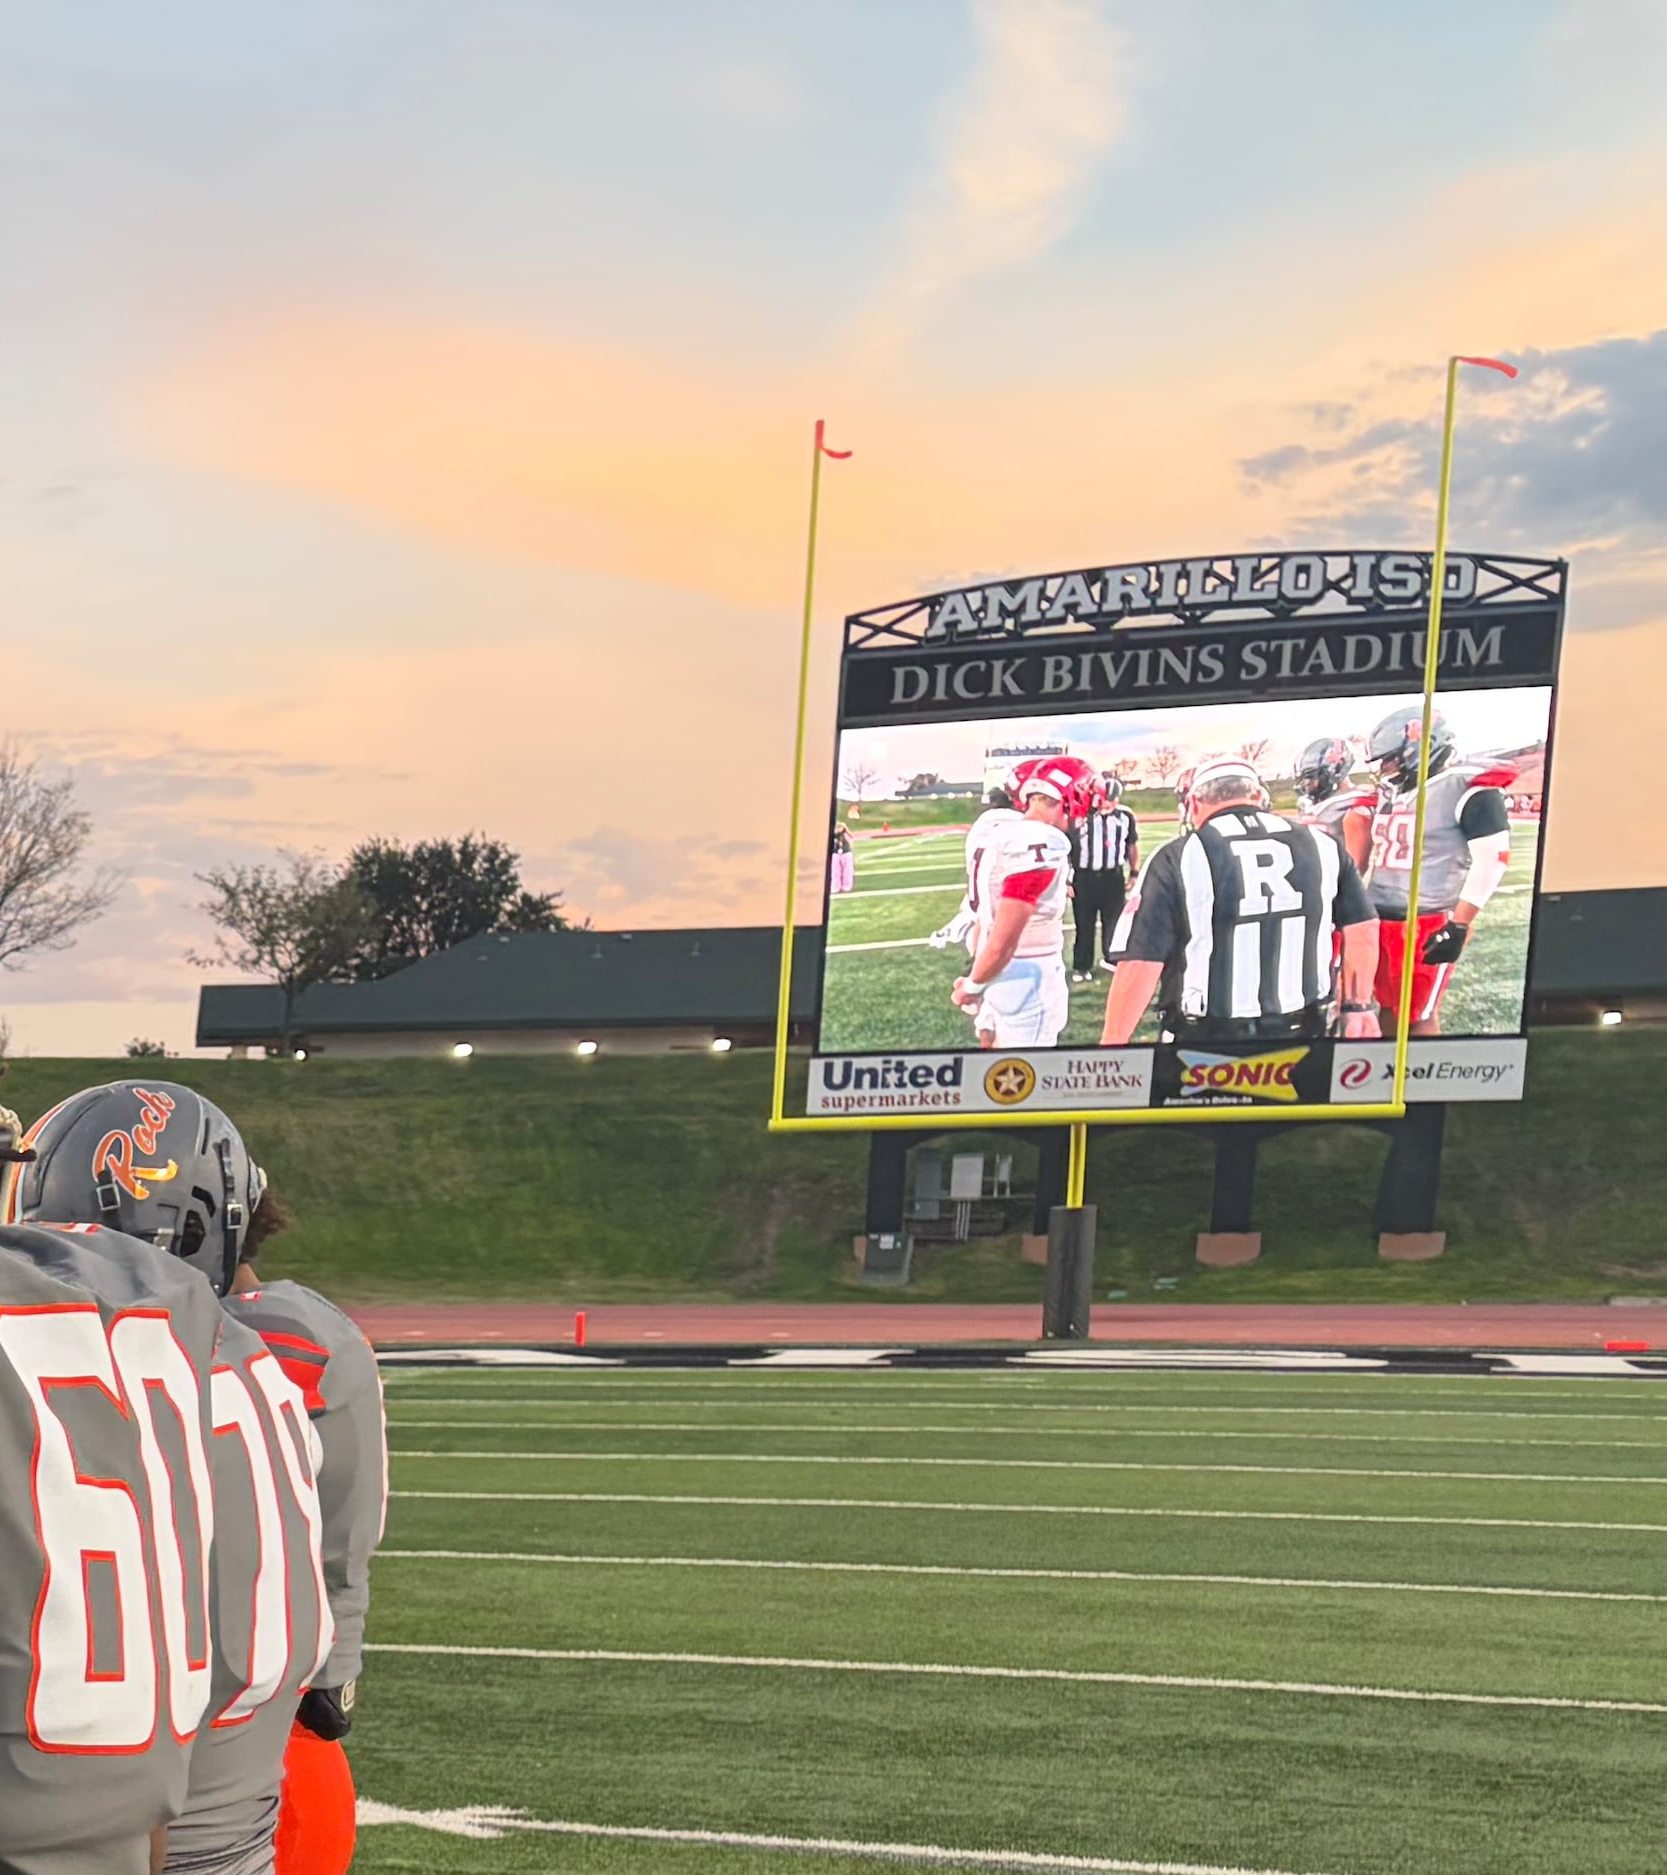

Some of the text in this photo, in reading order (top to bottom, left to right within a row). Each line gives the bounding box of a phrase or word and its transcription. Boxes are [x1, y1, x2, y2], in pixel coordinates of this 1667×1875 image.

[927, 553, 1478, 638] AMARILLO ISD
[890, 625, 1506, 705] DICK BIVINS STADIUM
[1229, 838, 1303, 917] R
[823, 1057, 964, 1091] United
[1041, 1073, 1144, 1090] STATE BANK
[1067, 1059, 1125, 1075] HAPPY
[1185, 1061, 1298, 1087] SONIC
[1435, 1061, 1508, 1083] Energy
[821, 1089, 962, 1113] supermarkets
[91, 1087, 179, 1200] Rock
